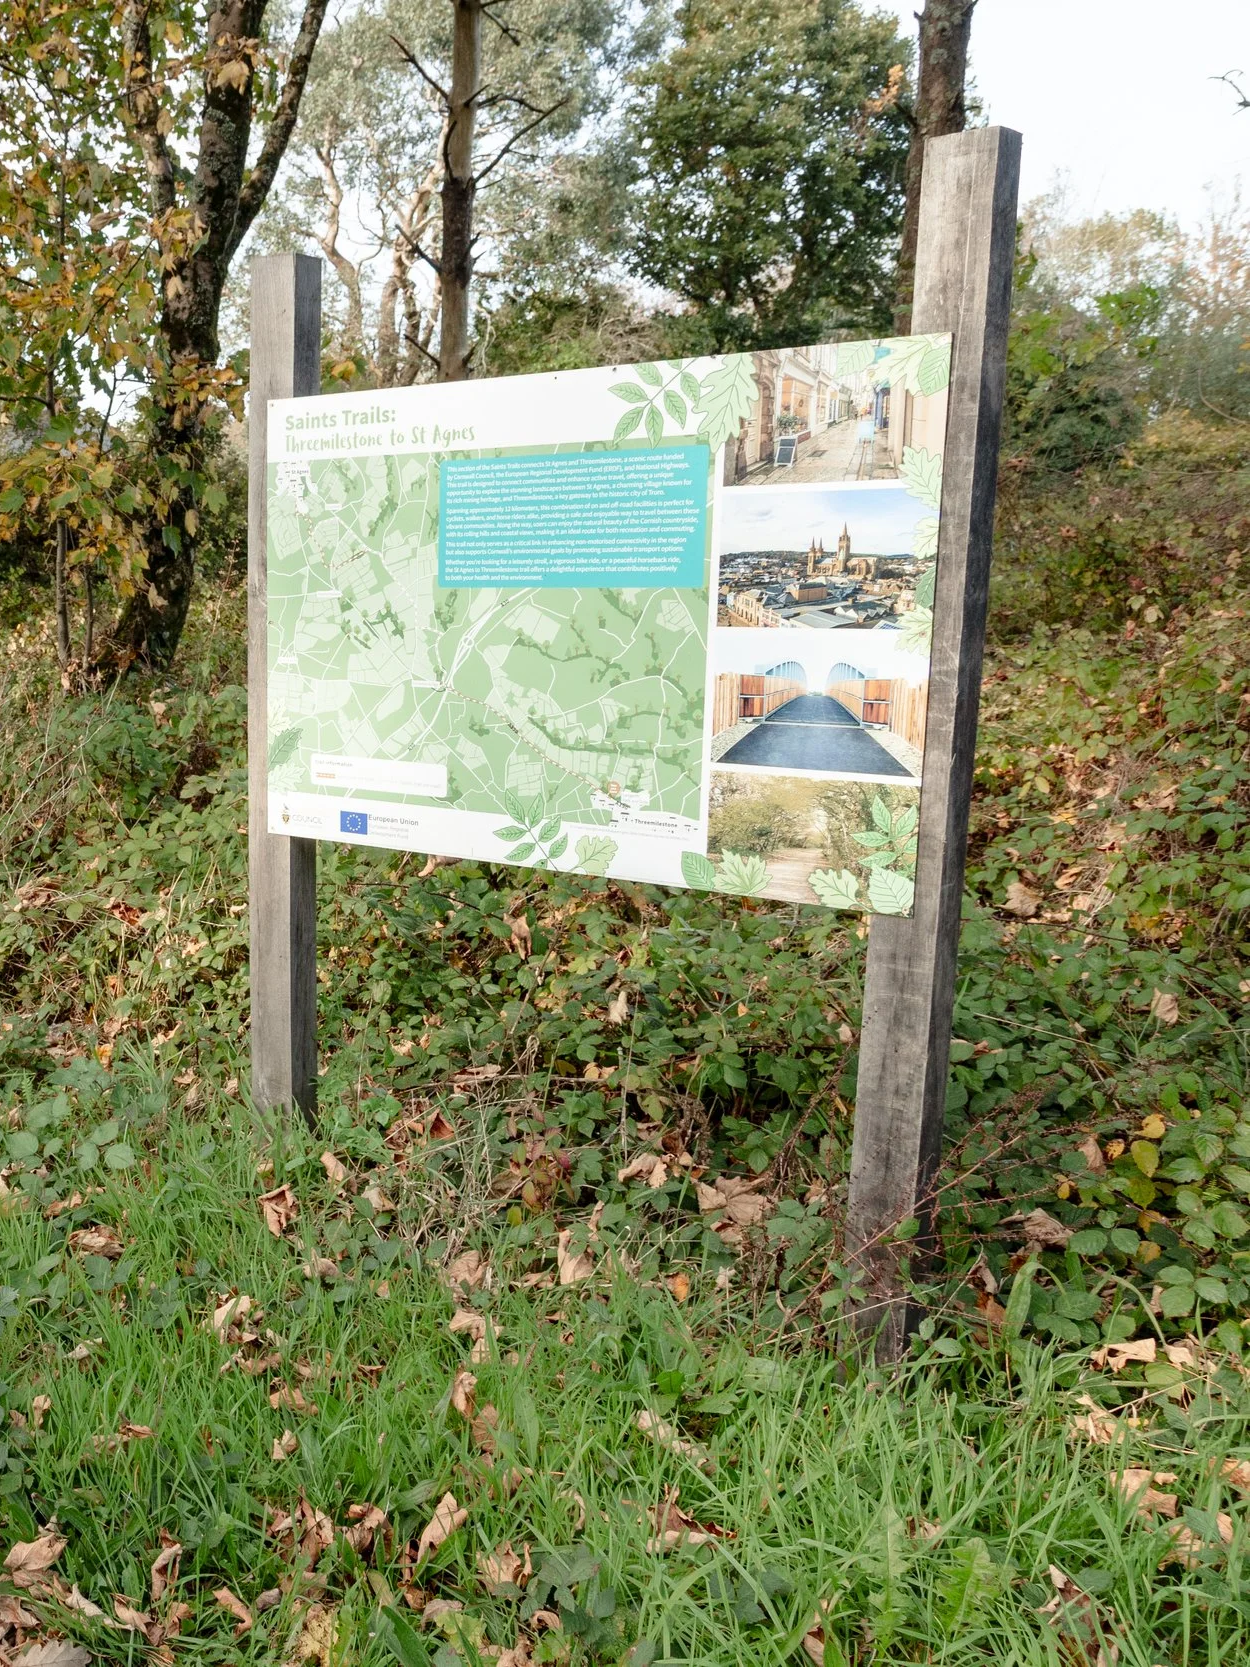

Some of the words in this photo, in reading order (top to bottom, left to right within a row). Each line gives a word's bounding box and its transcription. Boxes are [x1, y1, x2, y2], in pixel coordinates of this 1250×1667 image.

[285, 412, 337, 431] Saints
[342, 406, 396, 425] Trails:
[286, 432, 383, 453] Threemilestone
[390, 429, 404, 445] to
[412, 426, 426, 444] St
[433, 424, 475, 448] Agnes
[369, 814, 398, 824] European
[400, 818, 419, 827] Union
[635, 818, 678, 828] Threemilestone
